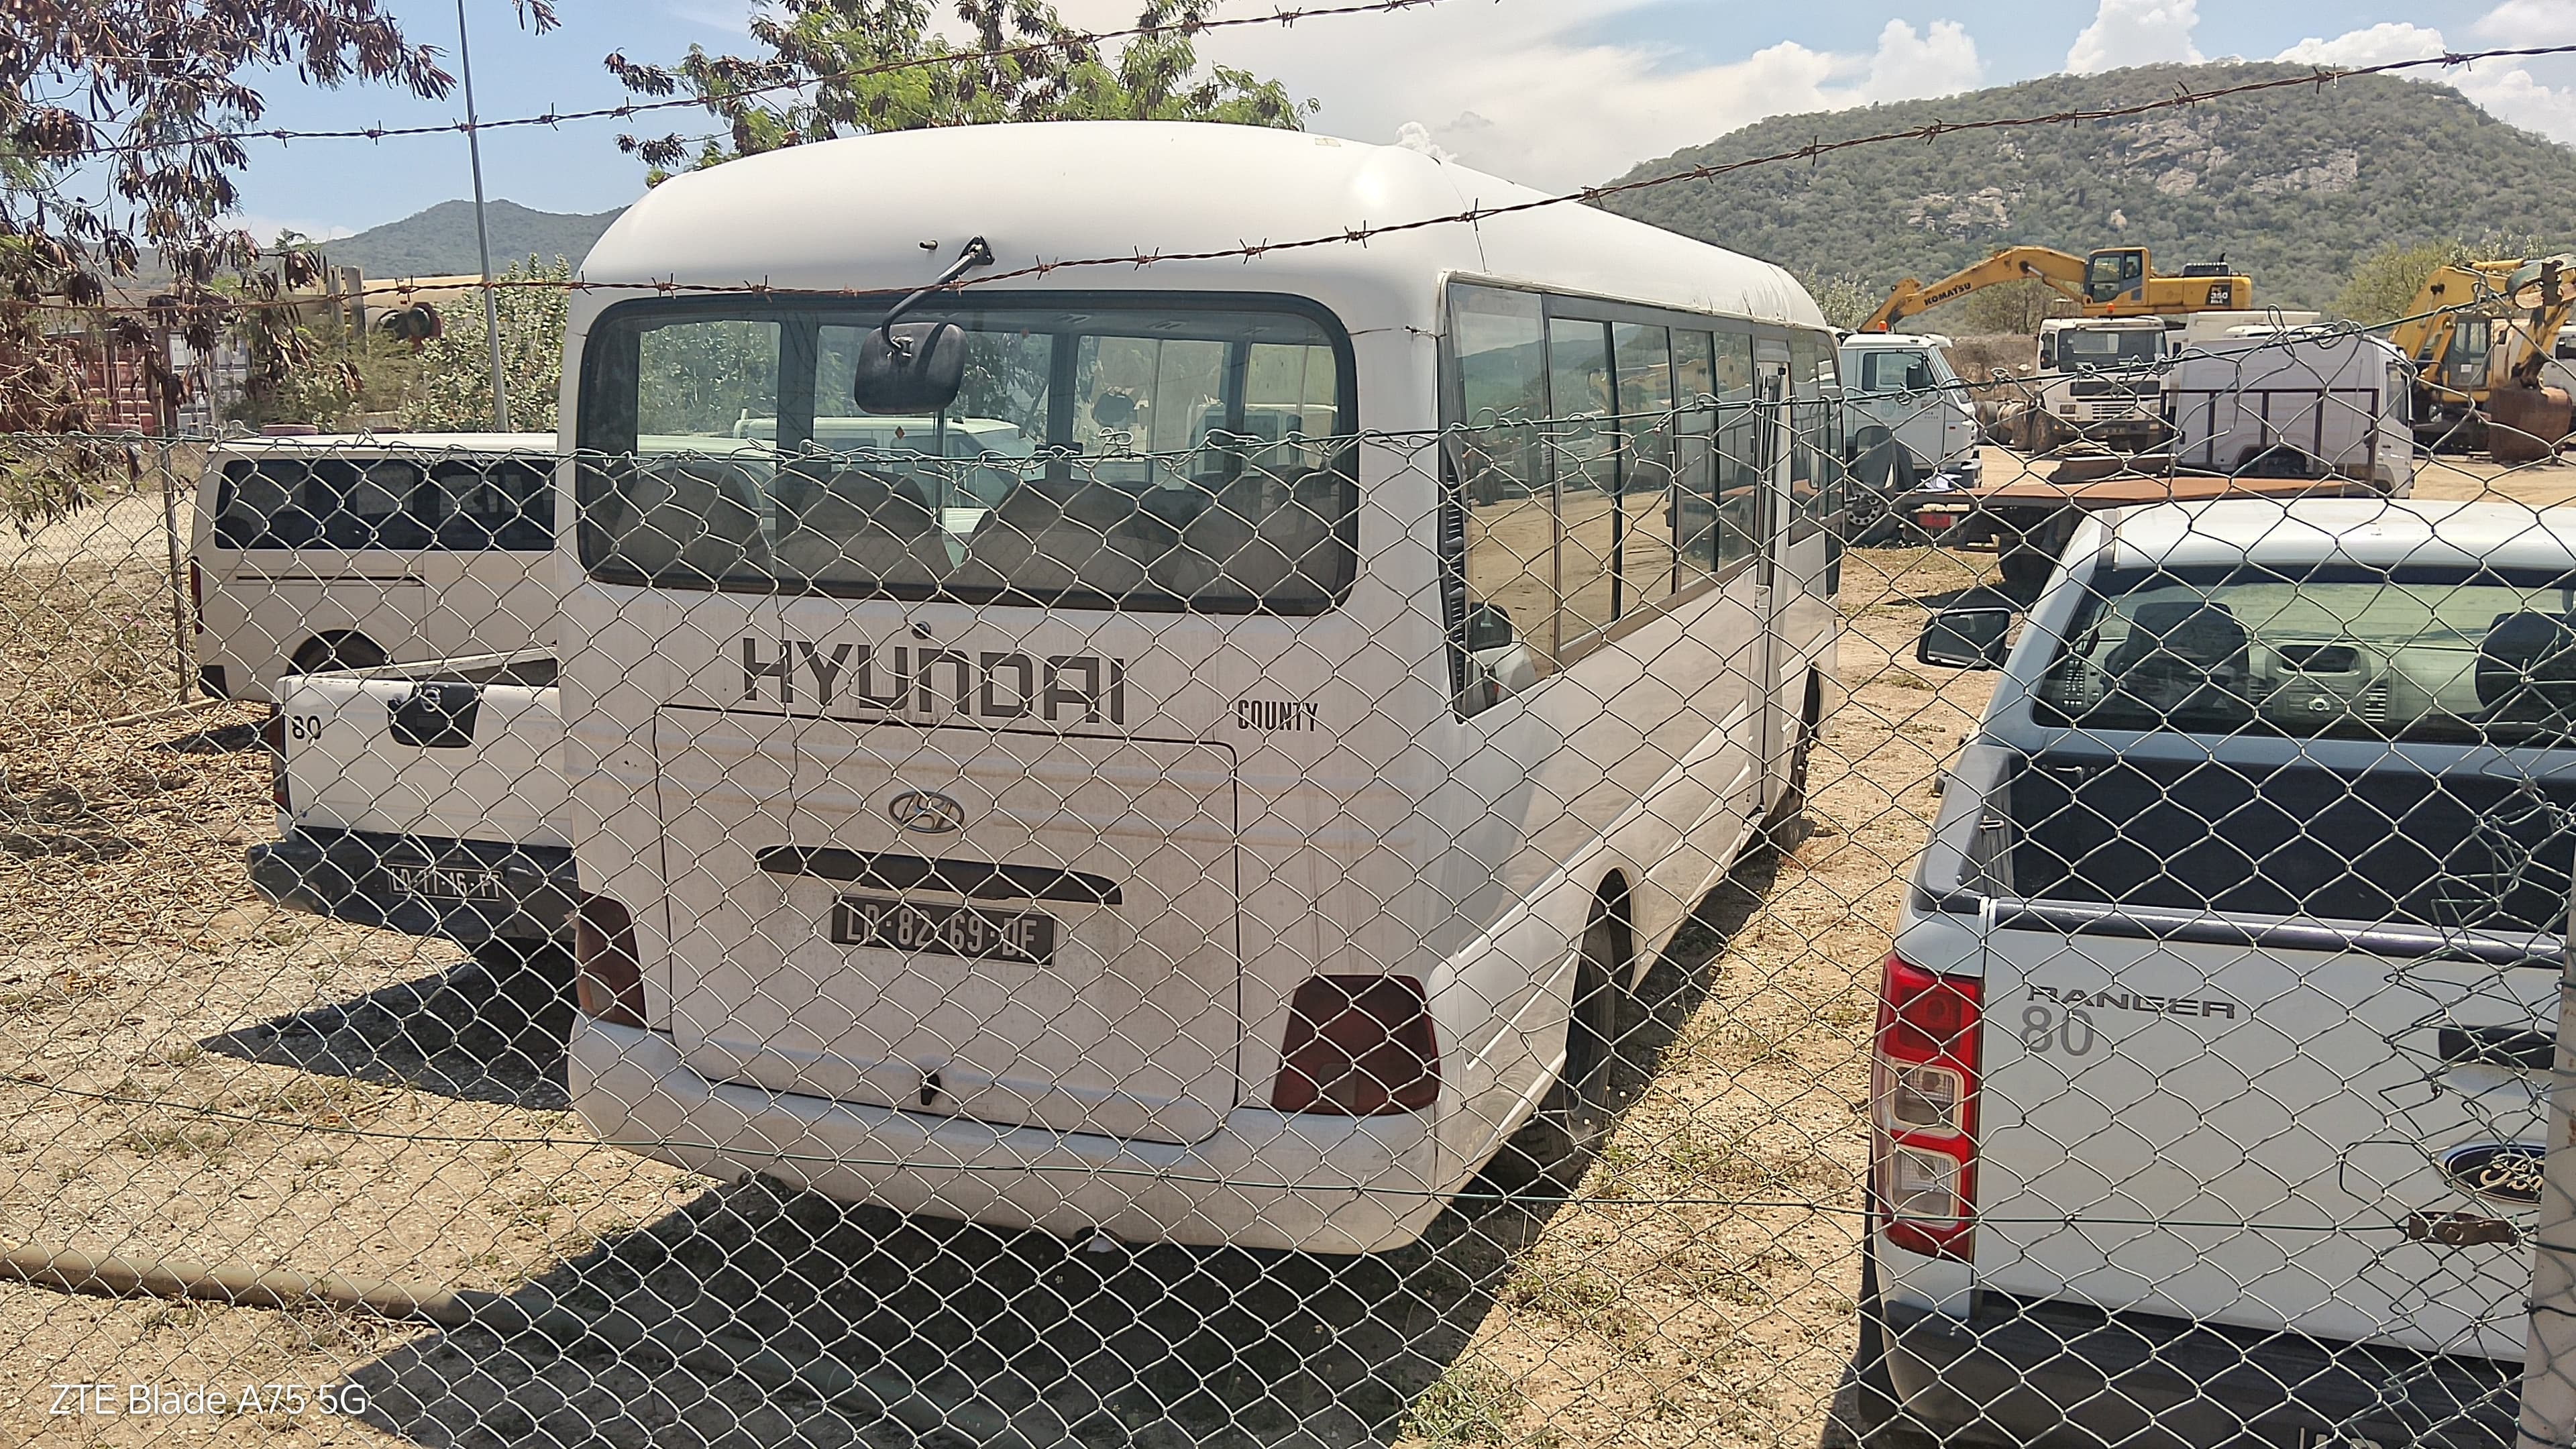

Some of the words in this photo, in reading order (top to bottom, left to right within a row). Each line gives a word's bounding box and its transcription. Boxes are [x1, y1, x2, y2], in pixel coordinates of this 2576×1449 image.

[1923, 282, 1972, 306] KOMATSU
[742, 637, 1126, 726] HYUNDAI
[291, 715, 322, 740] 80
[1238, 700, 1318, 732] COUNTY
[2027, 985, 2235, 1020] RANGER
[2019, 1005, 2094, 1057] 80
